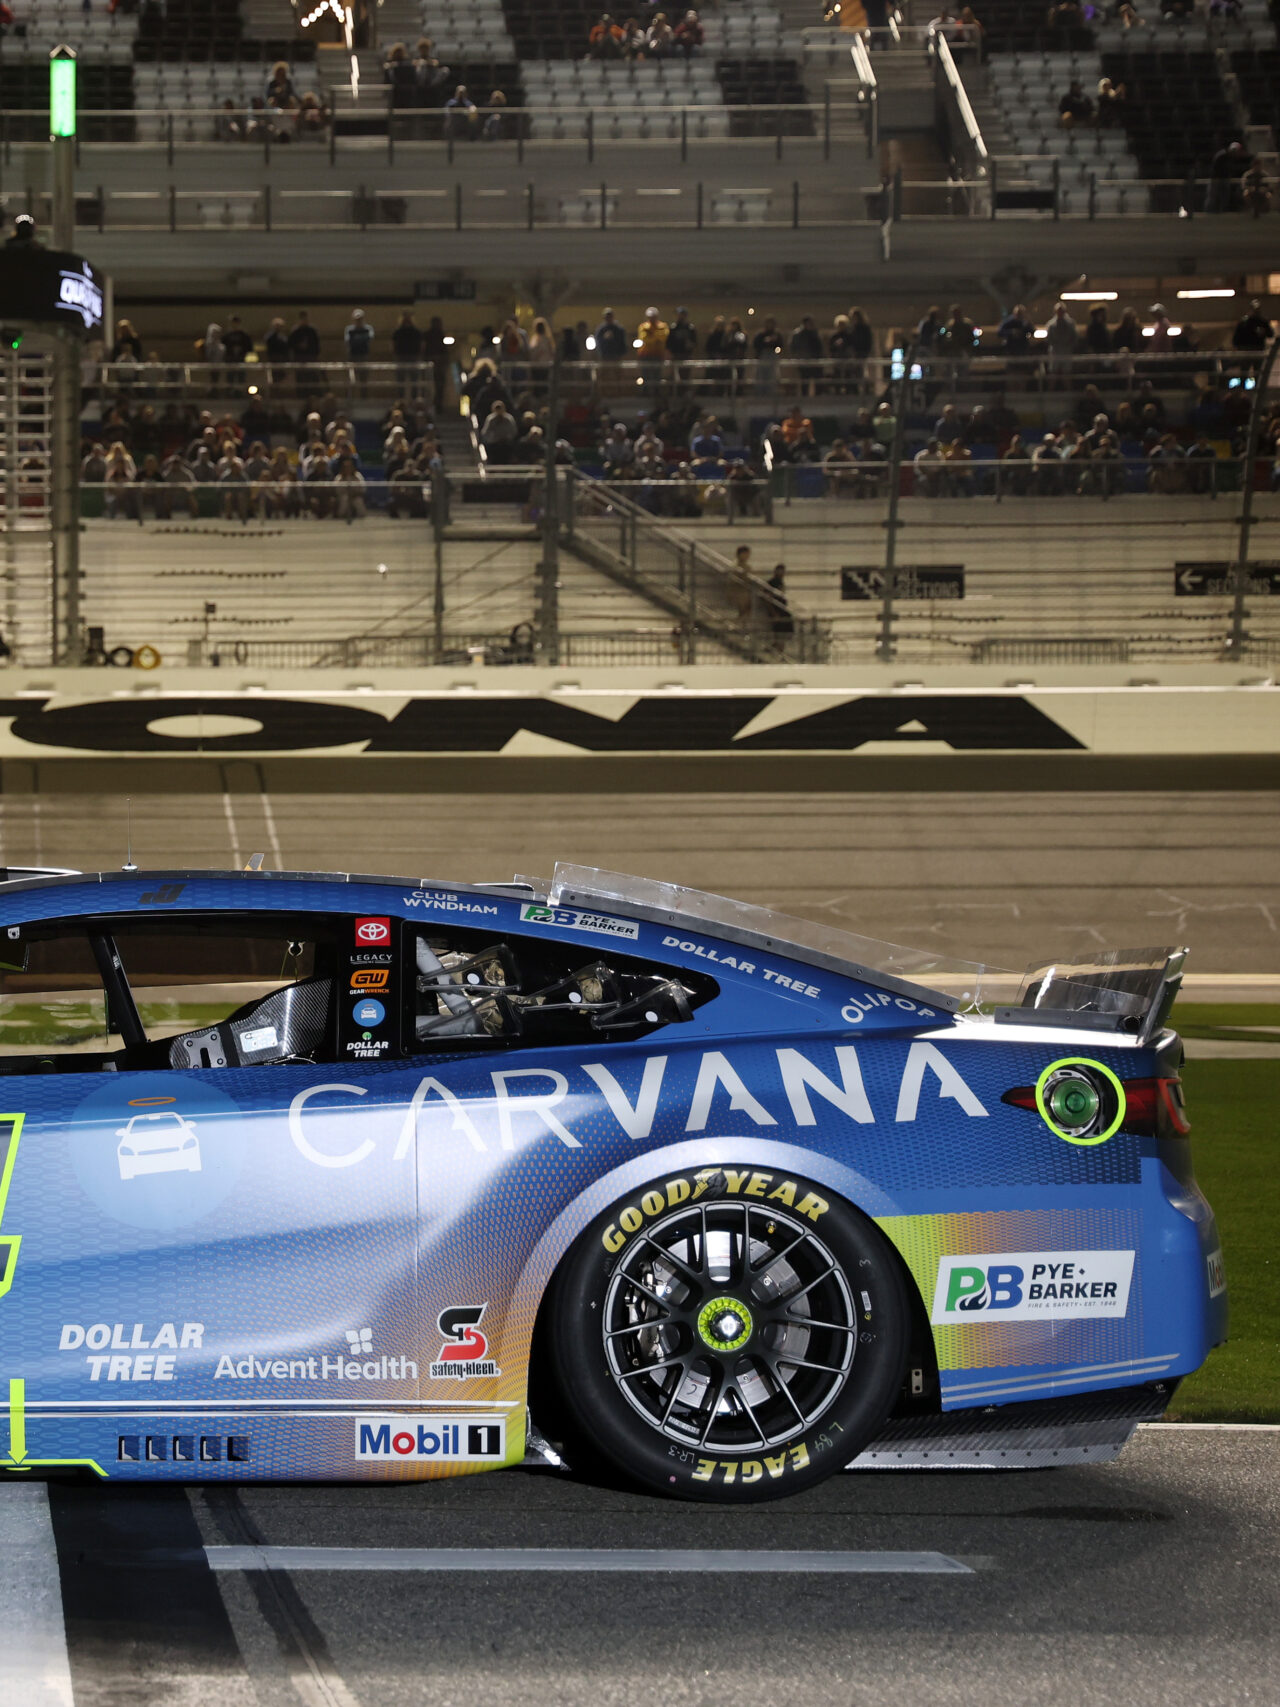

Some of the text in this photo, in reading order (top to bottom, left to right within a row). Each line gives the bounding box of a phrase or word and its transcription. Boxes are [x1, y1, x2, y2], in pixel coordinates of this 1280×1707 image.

[403, 897, 499, 916] WYNDHAM
[411, 890, 459, 902] CLUB
[579, 920, 635, 935] BARKER
[350, 954, 393, 962] LEGACY
[661, 935, 822, 999] DOLLAR TREE
[841, 992, 936, 1024] OLIPOP
[346, 1041, 389, 1051] DOLLAR
[353, 1049, 381, 1058] TREE
[288, 1041, 990, 1169] CARVANA
[1028, 1281, 1119, 1300] BARKER
[57, 1322, 206, 1351] DOLLAR
[84, 1355, 177, 1382] TREE
[358, 1422, 460, 1456] Mobil
[690, 1441, 811, 1484] EAGLE
